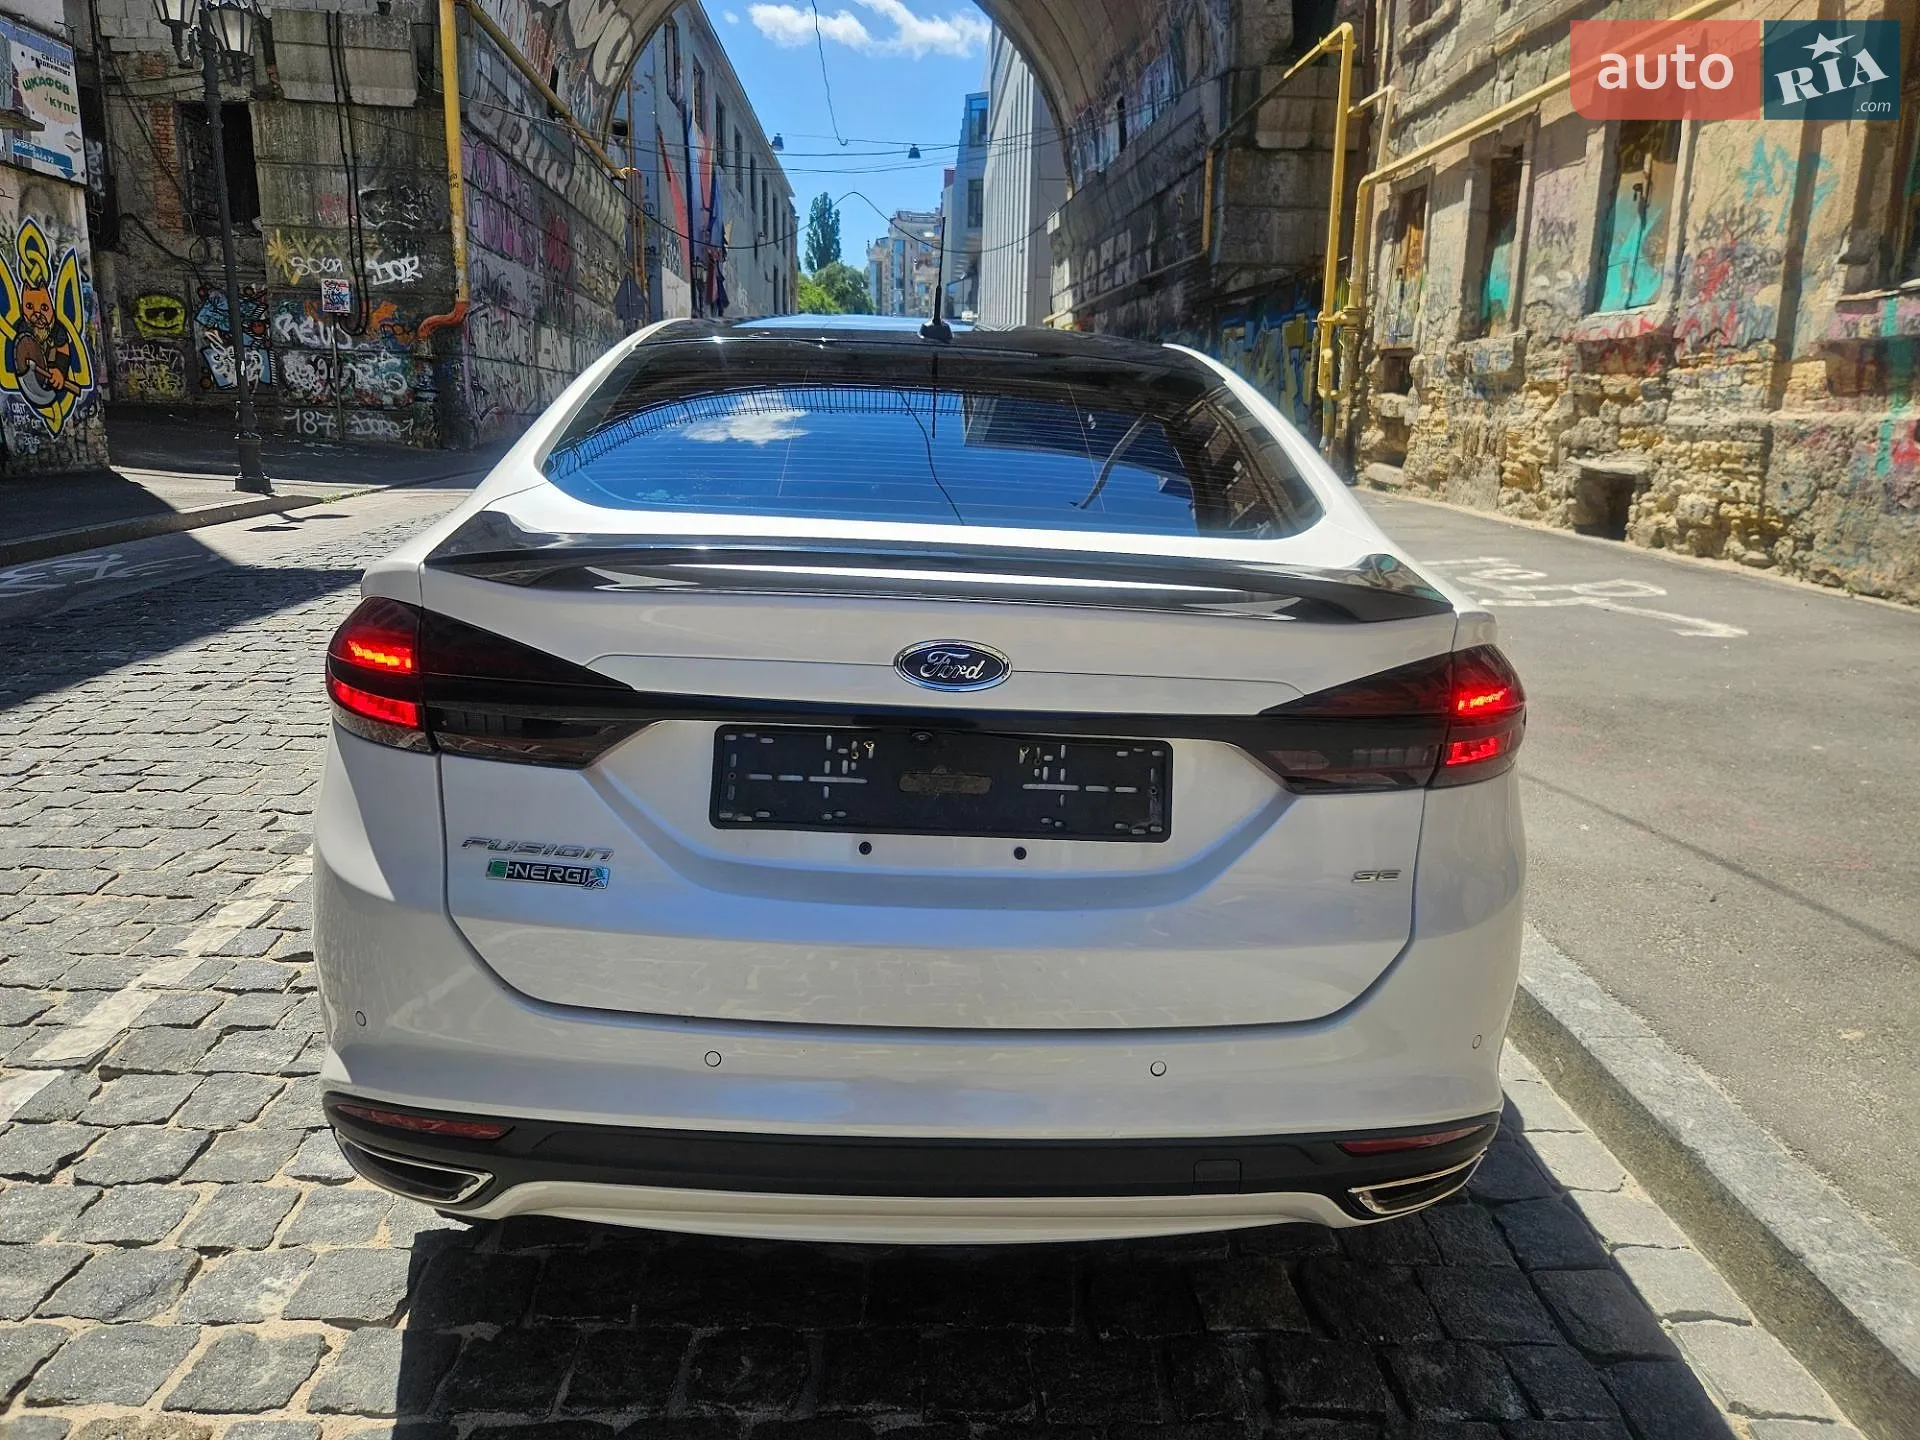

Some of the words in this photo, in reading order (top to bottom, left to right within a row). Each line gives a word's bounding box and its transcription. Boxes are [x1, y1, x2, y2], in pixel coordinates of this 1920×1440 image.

[920, 650, 985, 680] Ford
[461, 836, 615, 862] FUSION
[1351, 869, 1402, 884] SE
